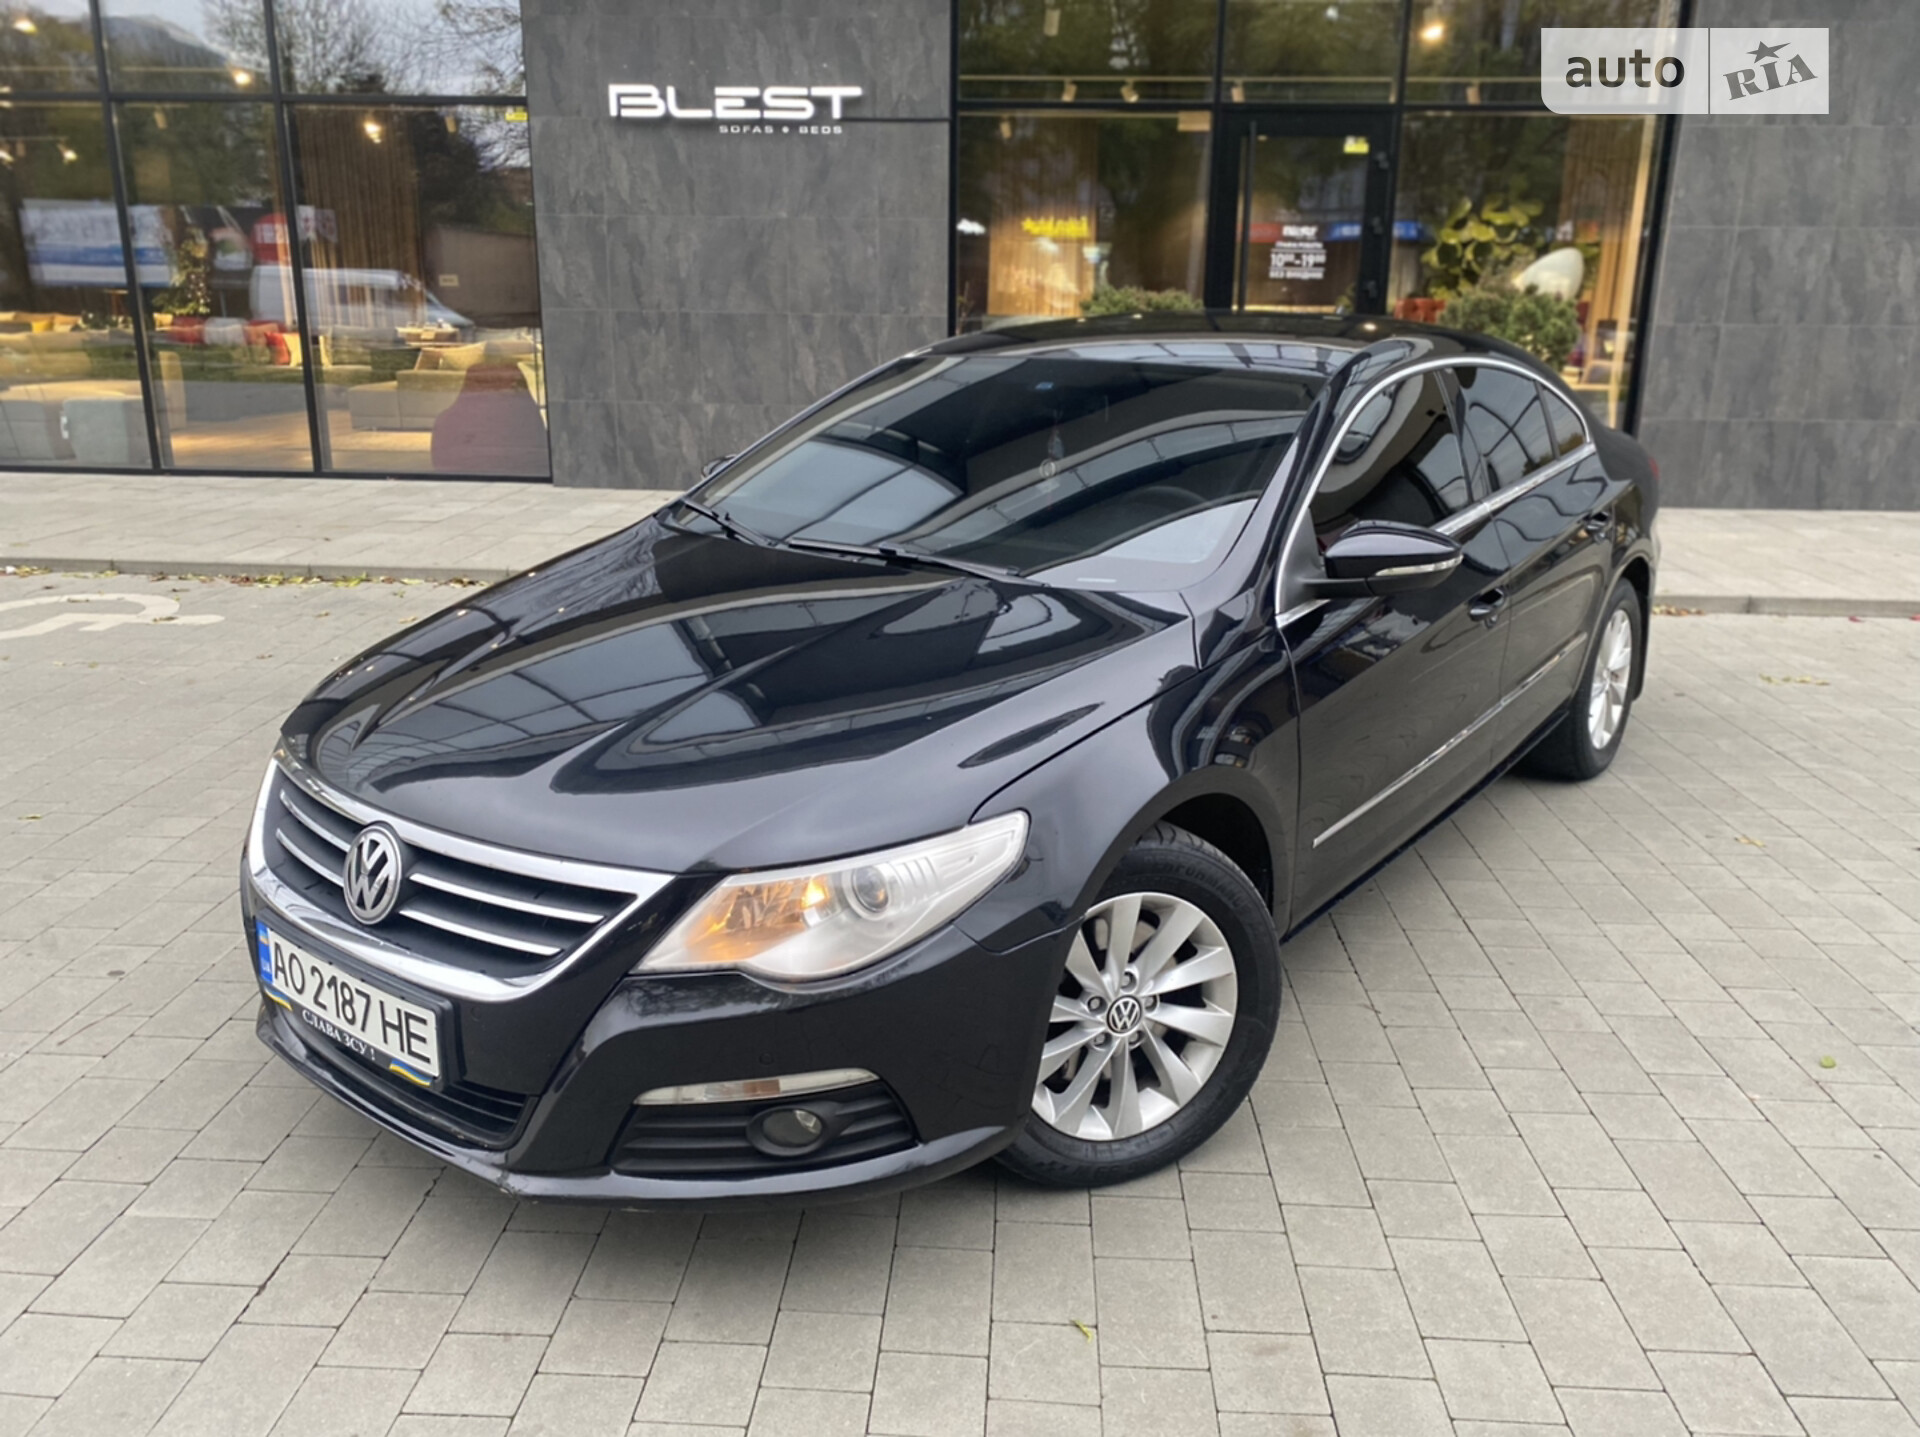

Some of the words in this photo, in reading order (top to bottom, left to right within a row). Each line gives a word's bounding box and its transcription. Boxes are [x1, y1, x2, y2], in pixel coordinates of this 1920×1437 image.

[608, 83, 863, 120] BLEST
[718, 124, 774, 134] SOFAS
[798, 124, 843, 135] BEDS
[274, 942, 305, 995] AO
[311, 965, 371, 1033] 2187
[379, 1000, 431, 1064] HE
